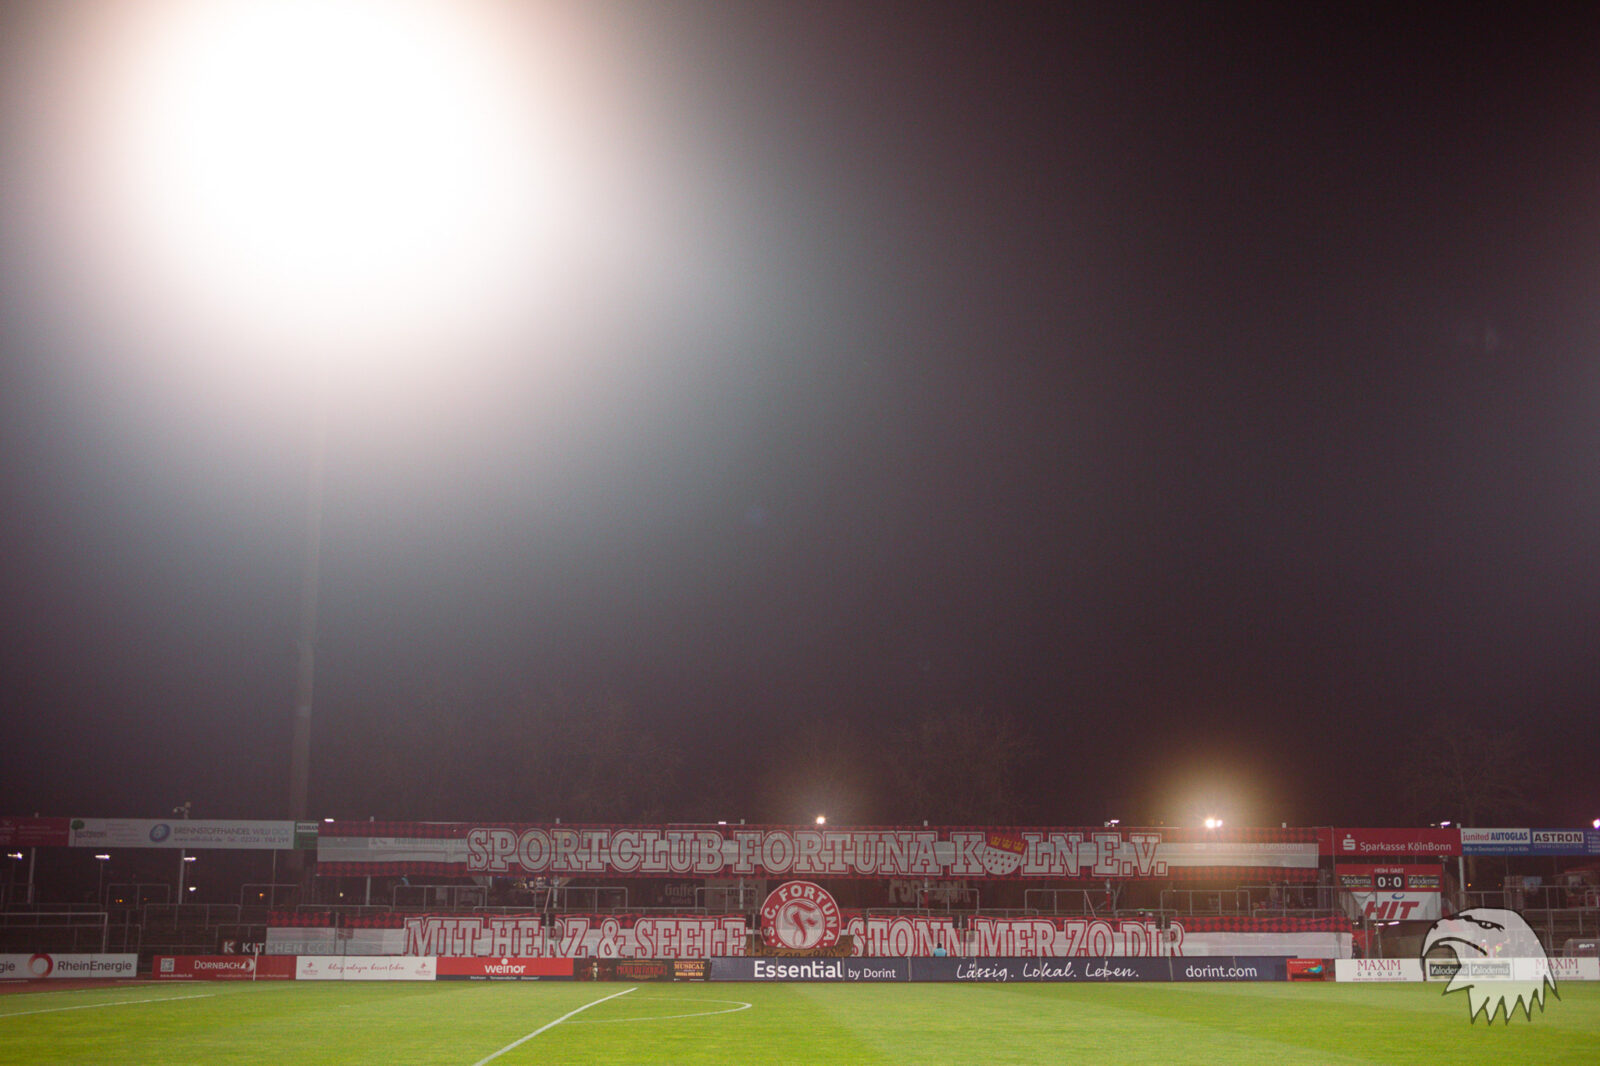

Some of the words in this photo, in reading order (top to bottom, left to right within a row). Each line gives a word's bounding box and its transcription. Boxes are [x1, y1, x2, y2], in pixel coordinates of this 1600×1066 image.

[1463, 832, 1490, 842] junited
[1490, 832, 1528, 841] AUTOGLAS
[1534, 833, 1583, 843] ASTRON
[467, 828, 727, 874] SPORTCLUB
[733, 830, 943, 875] FORTUNA
[1092, 832, 1168, 877] E.V.
[1360, 842, 1406, 853] Sparkasse
[1408, 841, 1452, 852] KölnBonn
[779, 885, 837, 940] FORTUNA
[1364, 901, 1420, 919] HIT
[403, 917, 484, 958] MIT
[597, 918, 628, 958] &
[633, 918, 748, 958] SEELE
[974, 918, 1056, 958] MER
[1063, 919, 1116, 959] ZO
[57, 960, 133, 973] RheinEnergie
[194, 960, 240, 969] DORNBACH
[484, 958, 527, 974] weinor
[753, 960, 843, 978] Essential
[848, 968, 861, 979] by
[863, 967, 896, 978] Dorint
[1357, 960, 1401, 971] MAXIM
[1536, 958, 1578, 970] MAXIM
[956, 962, 1015, 982] Lässig.
[1022, 963, 1077, 978] Lokal.
[1085, 962, 1140, 978] Leben.
[1185, 966, 1258, 978] dorint.com
